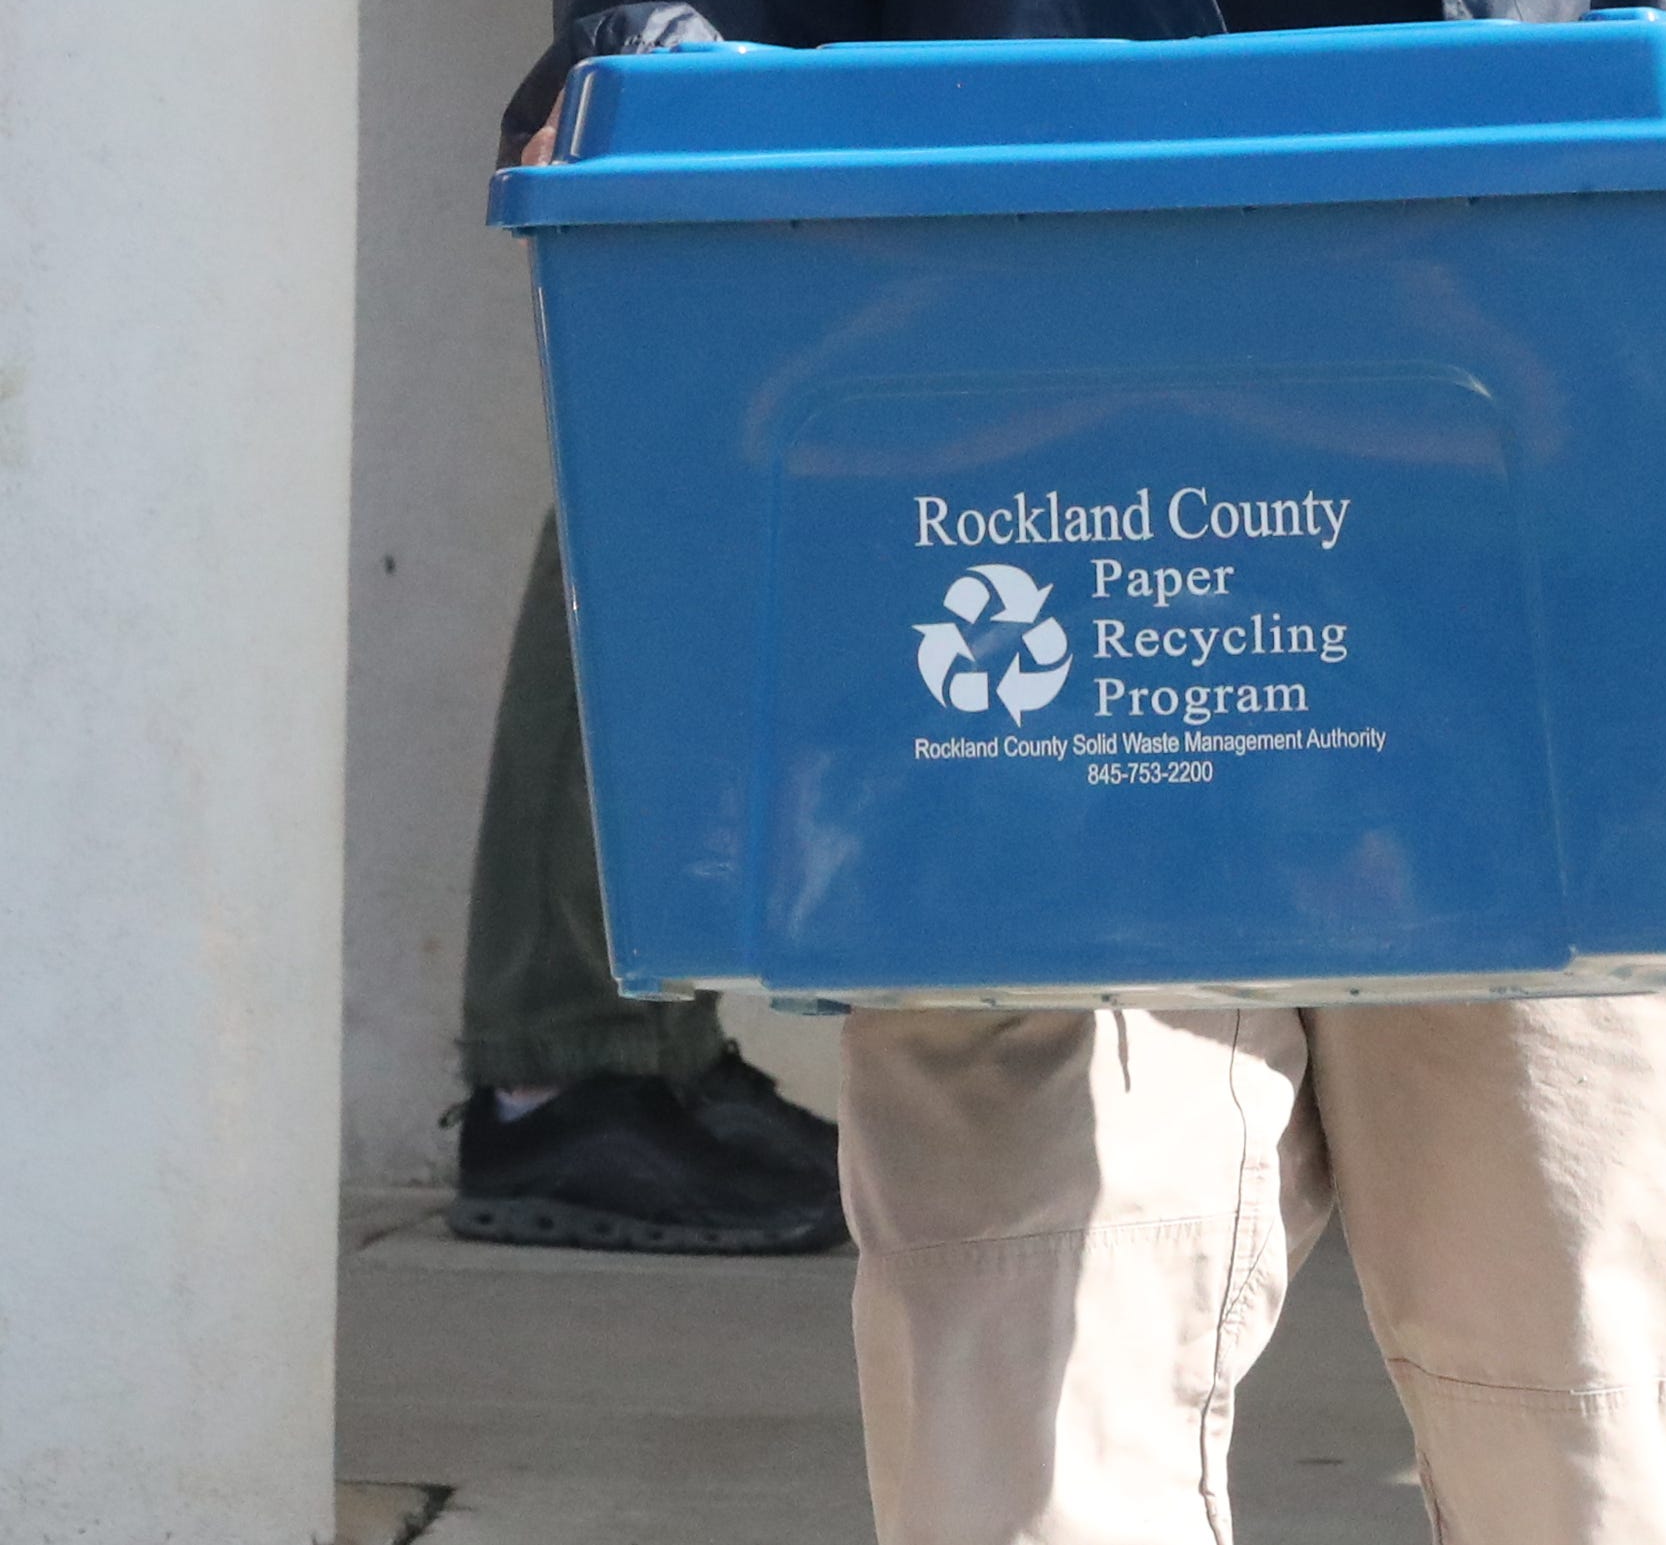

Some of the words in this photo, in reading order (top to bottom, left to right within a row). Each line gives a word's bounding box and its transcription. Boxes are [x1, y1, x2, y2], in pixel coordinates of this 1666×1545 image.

[914, 488, 1154, 547] Rockland
[1168, 487, 1351, 550] County
[1091, 559, 1235, 608] Paper
[1093, 613, 1348, 667] Recycling
[1094, 678, 1309, 726] Program
[914, 737, 998, 759] Rockland
[1004, 736, 1067, 760] County
[1073, 733, 1117, 755] Solid
[1121, 732, 1180, 754] Waste
[1184, 730, 1303, 755] Management
[1306, 728, 1386, 752] Authority
[1087, 761, 1214, 785] 845-753-2200
